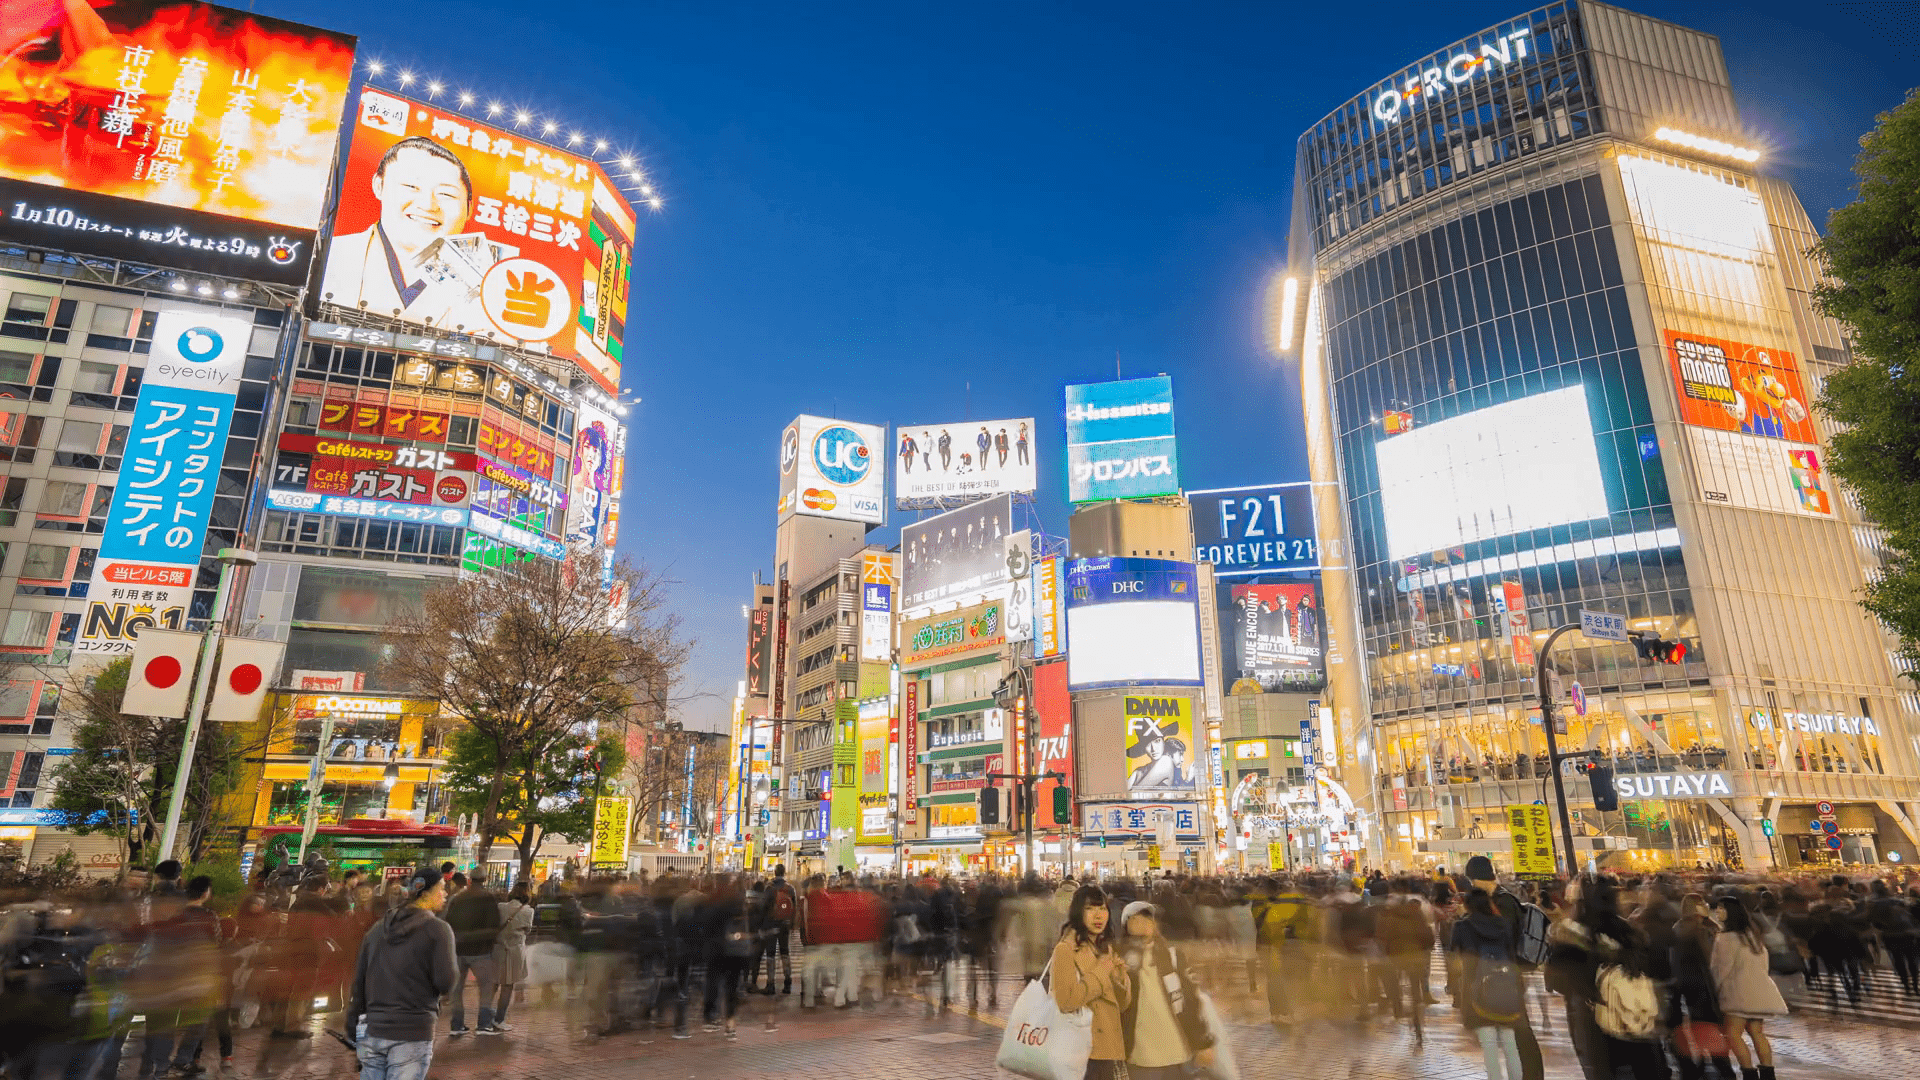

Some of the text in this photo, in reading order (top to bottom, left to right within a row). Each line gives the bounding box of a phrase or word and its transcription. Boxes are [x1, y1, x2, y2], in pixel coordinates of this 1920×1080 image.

[1374, 28, 1530, 123] QFRONT
[102, 45, 154, 149] 市村正親
[11, 202, 134, 237] 1月10日スタート
[475, 196, 581, 251] 五拾三次
[502, 270, 555, 328] 当
[1676, 340, 1725, 363] SUPER
[159, 364, 229, 385] eyecity
[1680, 357, 1731, 388] MARIO
[1706, 385, 1735, 403] RUN
[324, 404, 442, 436] プライス
[479, 424, 551, 470] コンタクト
[396, 448, 455, 471] ガスト
[1072, 455, 1172, 482] サロンパス
[122, 401, 187, 546] アイシティ
[165, 406, 220, 549] コンタクトの
[277, 465, 308, 483] 7F
[315, 469, 348, 484] Café
[350, 470, 426, 499] ガスト
[313, 481, 347, 491] レストラン
[439, 487, 464, 496] ガスト
[530, 482, 562, 507] ガスト
[927, 483, 944, 492] BEST
[274, 493, 313, 507] AEON
[326, 497, 437, 521] 英会話イーオン
[854, 501, 878, 511] VISA
[1197, 539, 1316, 566] FOREVER 21
[113, 567, 185, 584] 当ビル5階
[1112, 581, 1144, 594] DHC
[111, 588, 169, 601] 利用者数
[1245, 591, 1258, 668] BLUE ENCOUNT
[1584, 614, 1623, 630] 渋谷駅前
[78, 642, 134, 652] コンタクト
[1126, 698, 1180, 716] DMM
[1127, 718, 1163, 737] FX
[1784, 712, 1880, 736] TSUTAYA
[1038, 723, 1071, 782] クスリ
[1613, 773, 1731, 798] SUTAYA
[596, 798, 612, 850] 悔い改めよ
[1089, 809, 1193, 830] 大盛堂店
